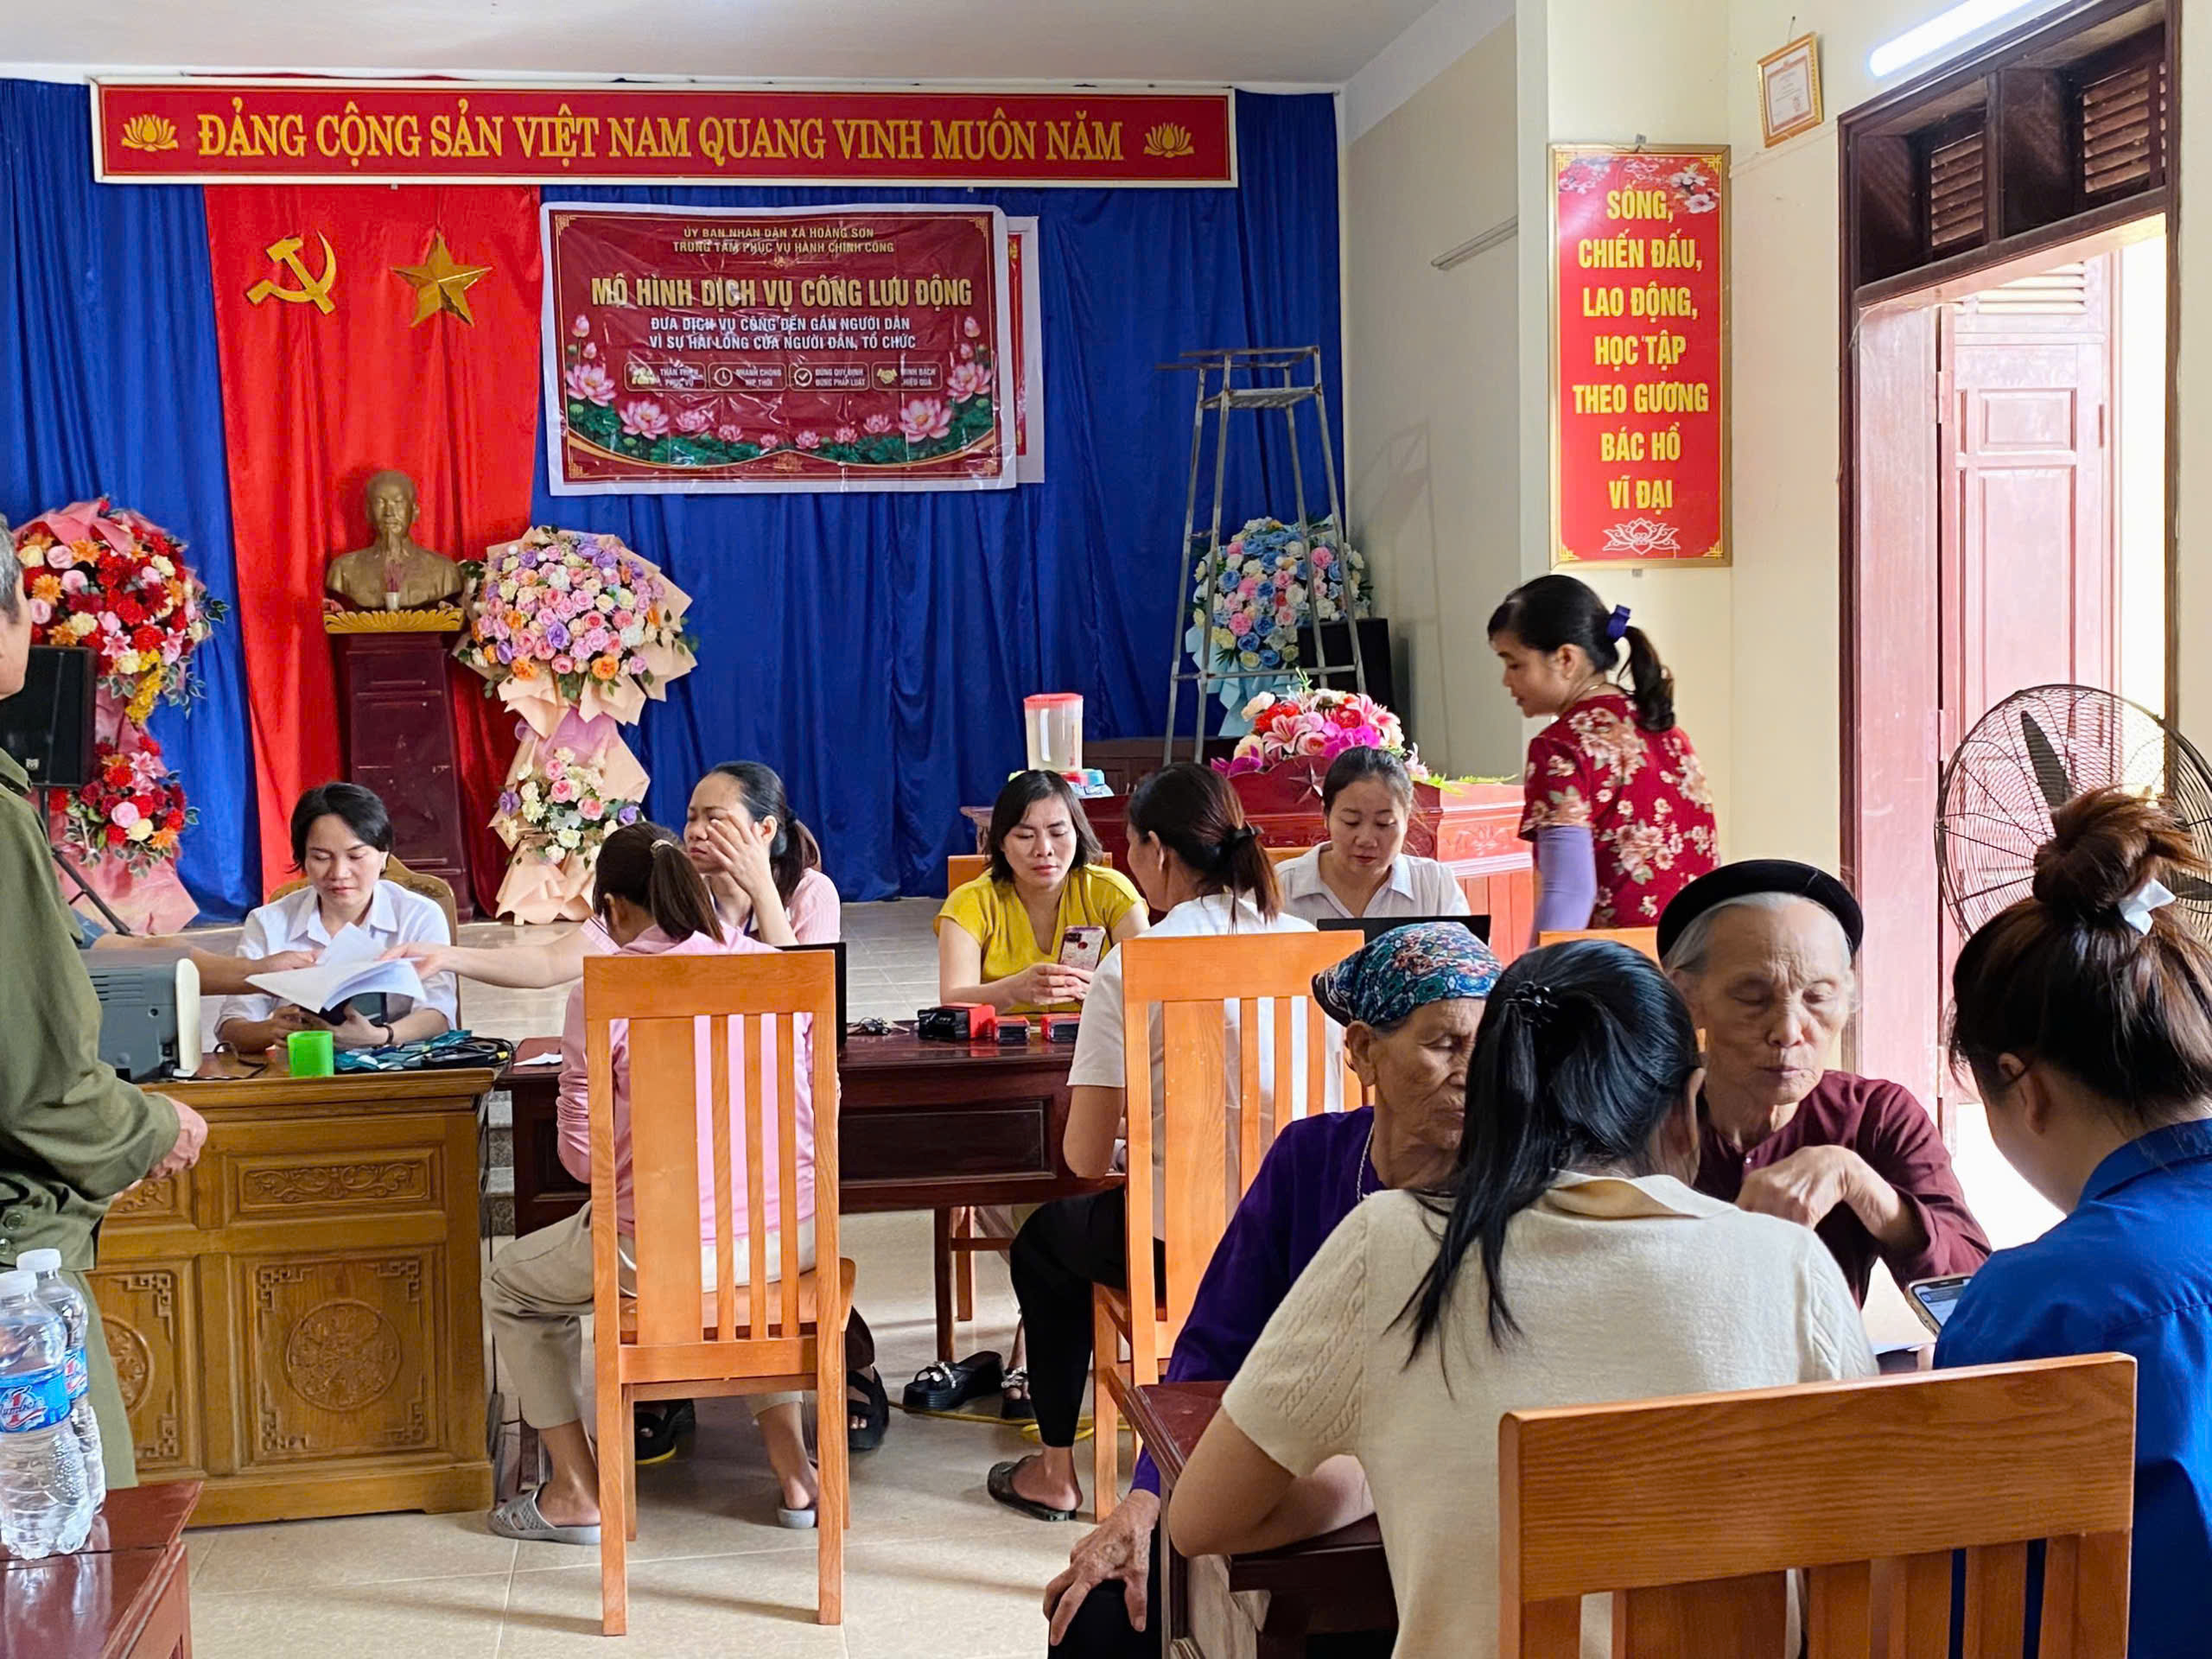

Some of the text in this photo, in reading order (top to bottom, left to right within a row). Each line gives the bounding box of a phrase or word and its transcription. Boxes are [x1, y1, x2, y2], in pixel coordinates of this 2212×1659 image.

[198, 98, 1124, 167] ĐẢNG CỘNG SẢN VIỆT NAM QUANG VINH MUÔN NĂM
[1606, 180, 1674, 223] SỐNG,
[673, 241, 710, 252] TRUNG
[743, 242, 772, 255] PHỤC
[777, 242, 791, 255] VỤ
[795, 240, 824, 252] HÀNH
[865, 240, 893, 252] CÔNG
[702, 228, 725, 238] BAN
[729, 227, 760, 238] NHÂN
[765, 227, 787, 238] DÂN
[1578, 228, 1702, 271] CHIẾN ĐẤU,
[591, 272, 972, 312] MÔ HÌNH DỊCH VỤ CÔNG LƯU ĐỘNG
[1583, 281, 1698, 323] LAO ĐỘNG,
[650, 334, 662, 349] VÌ
[667, 335, 684, 352] SỰ
[784, 334, 823, 349] NGƯỜI
[862, 333, 878, 349] TỔ
[882, 334, 916, 349] CHỨC
[651, 316, 677, 330] ĐƯA
[683, 317, 715, 334] DỊCH
[718, 318, 735, 333] VỤ
[741, 315, 776, 331] CÔNG
[780, 315, 806, 331] ĐẾN
[840, 316, 880, 331] NGƯỜI
[885, 315, 910, 330] DÂN
[1594, 329, 1687, 372] HỌC TẬP
[1572, 381, 1709, 414] THEO GƯƠNG
[1601, 422, 1681, 461] BÁC HỒ
[1609, 475, 1673, 515] VĨ ĐẠI
